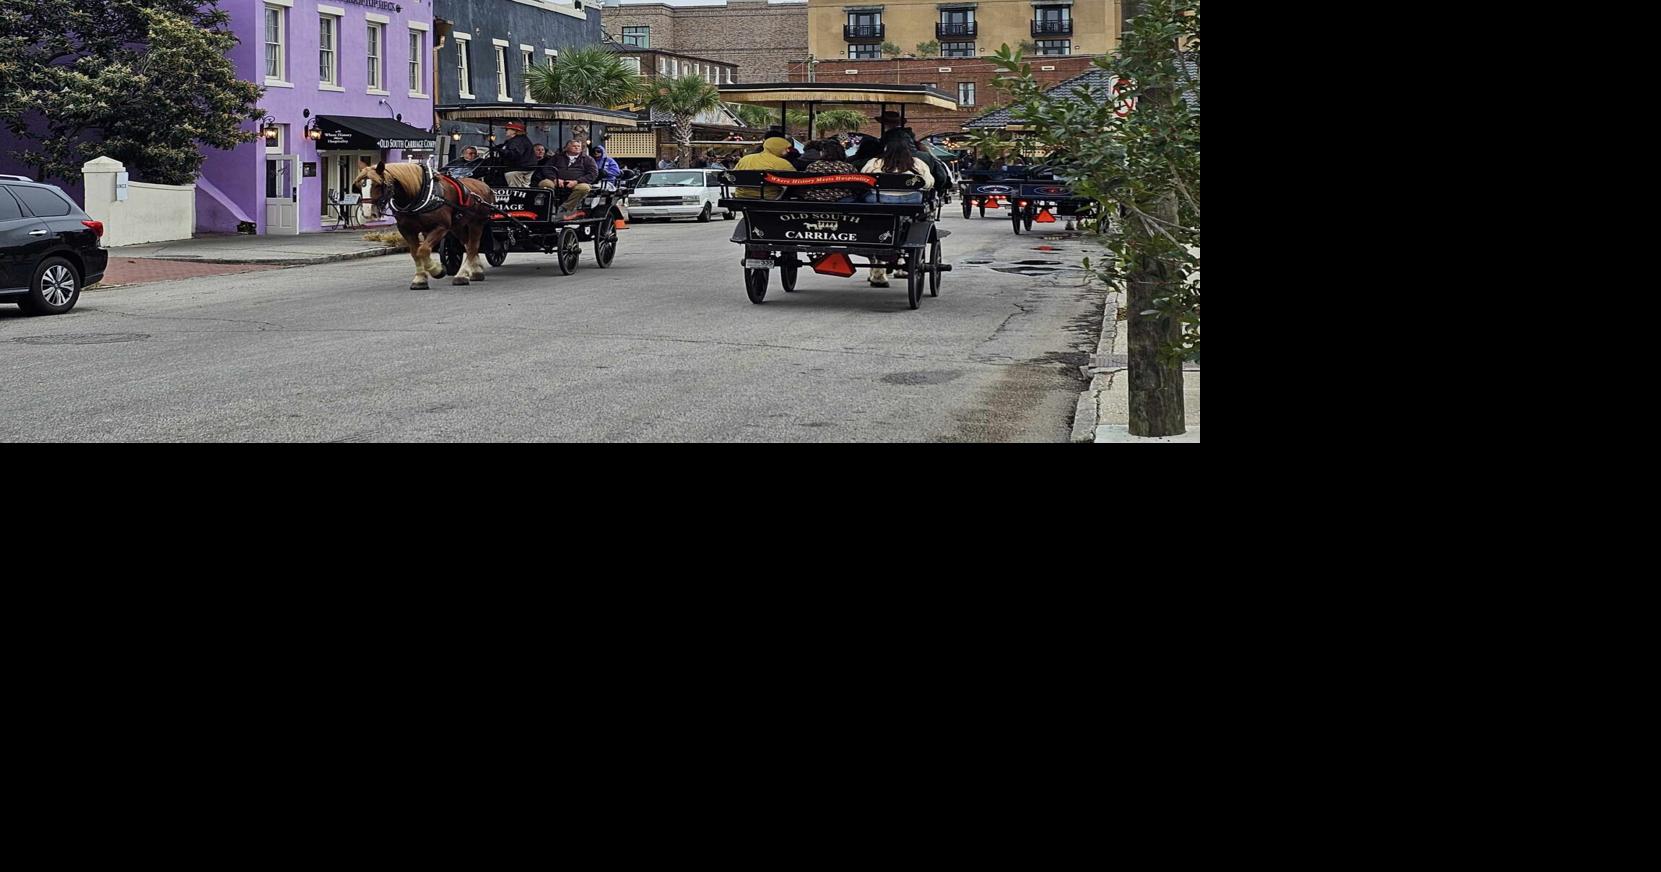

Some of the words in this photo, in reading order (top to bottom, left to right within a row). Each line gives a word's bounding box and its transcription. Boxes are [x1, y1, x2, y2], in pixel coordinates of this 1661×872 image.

[780, 212, 809, 222] OLD
[811, 212, 861, 224] SOUTH
[785, 230, 857, 241] CARRIAGE
